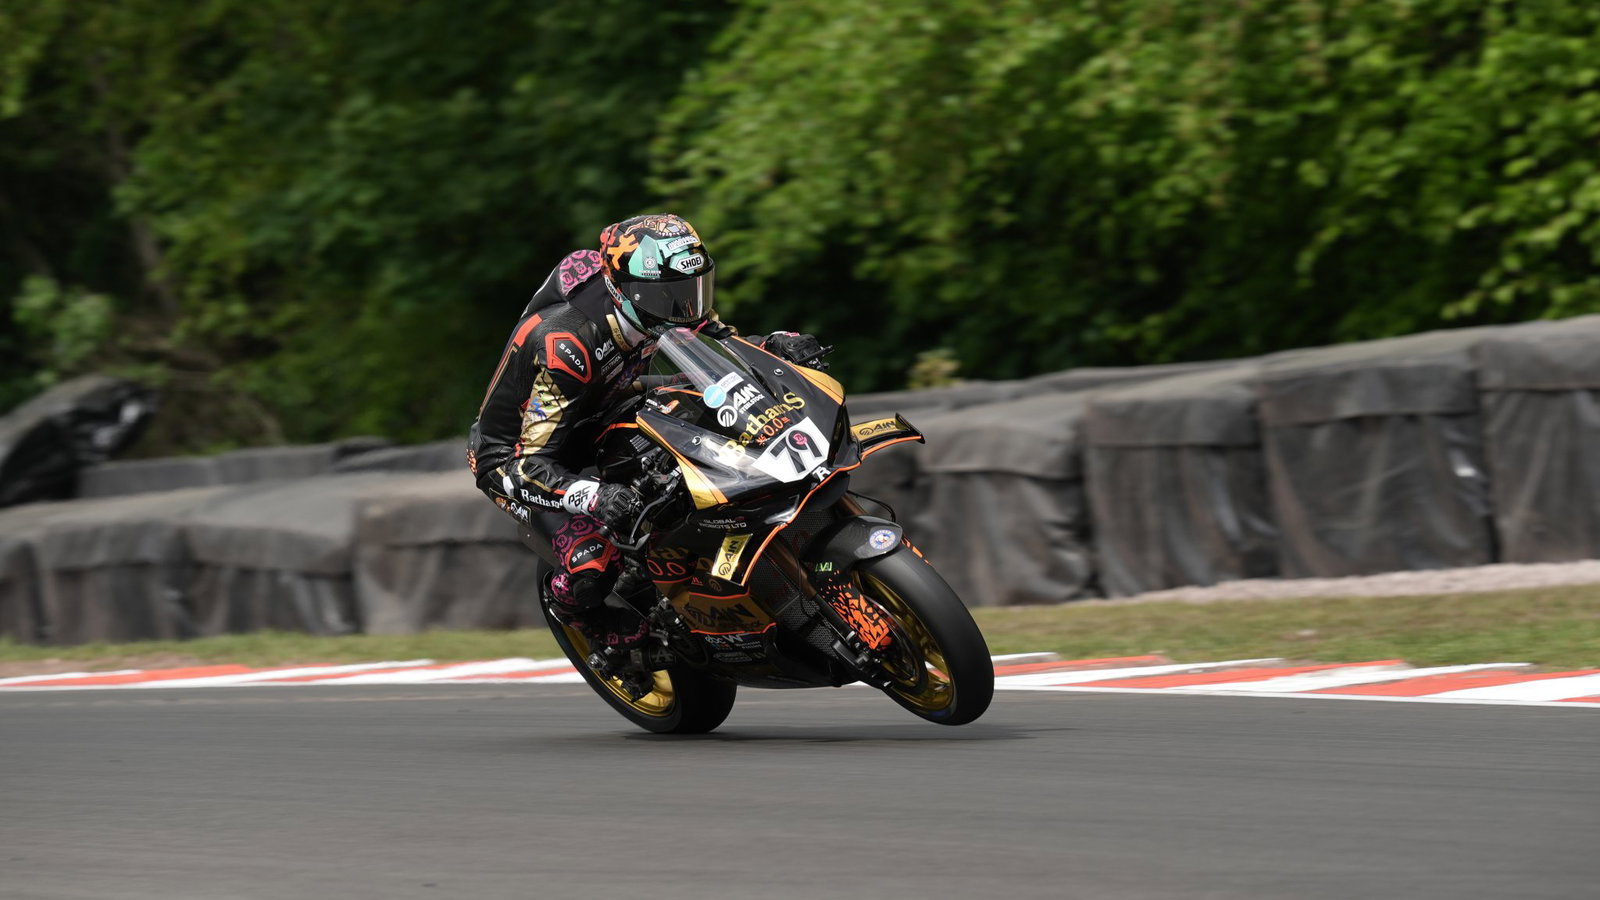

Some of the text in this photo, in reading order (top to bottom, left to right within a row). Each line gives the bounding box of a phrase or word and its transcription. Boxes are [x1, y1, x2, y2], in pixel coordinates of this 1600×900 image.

[680, 256, 702, 270] SHOEI
[559, 342, 585, 372] SPADA
[733, 383, 761, 410] AIN
[769, 430, 823, 474] 79
[571, 543, 603, 563] SPADA
[725, 540, 739, 562] AIN
